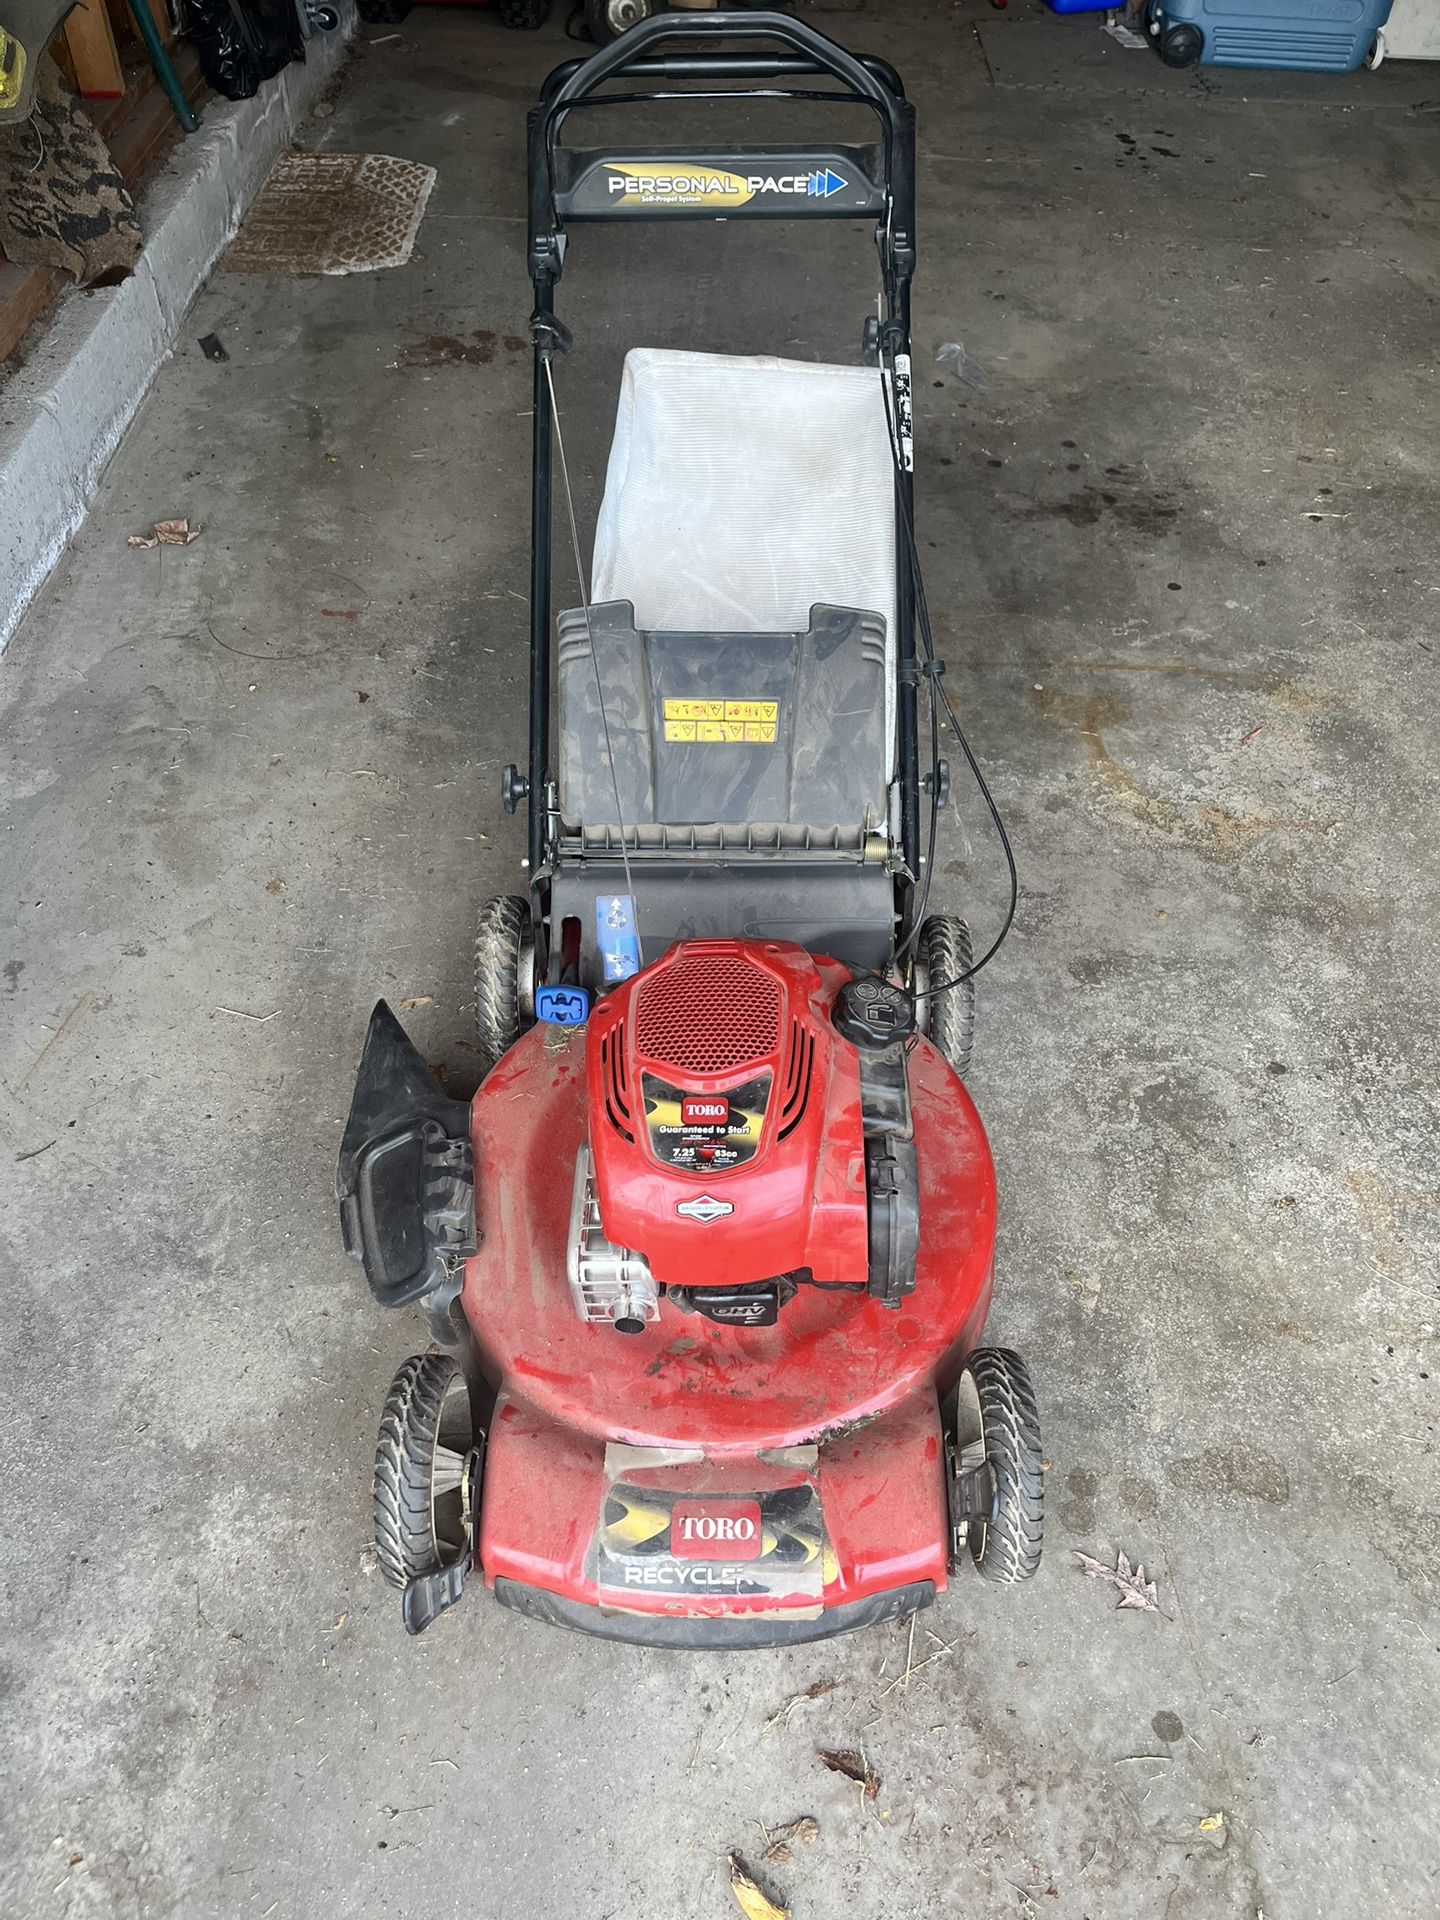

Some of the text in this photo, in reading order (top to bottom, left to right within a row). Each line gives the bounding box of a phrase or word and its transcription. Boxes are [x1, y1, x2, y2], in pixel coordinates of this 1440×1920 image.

[608, 176, 811, 194] PERSONAL PACE
[641, 195, 702, 204] Self-Propel System
[686, 1104, 726, 1116] TORO
[659, 1125, 750, 1134] Guaranteed to Start
[672, 1147, 695, 1157] 7.25
[712, 1305, 766, 1317] OHV
[678, 1516, 755, 1540] TORO
